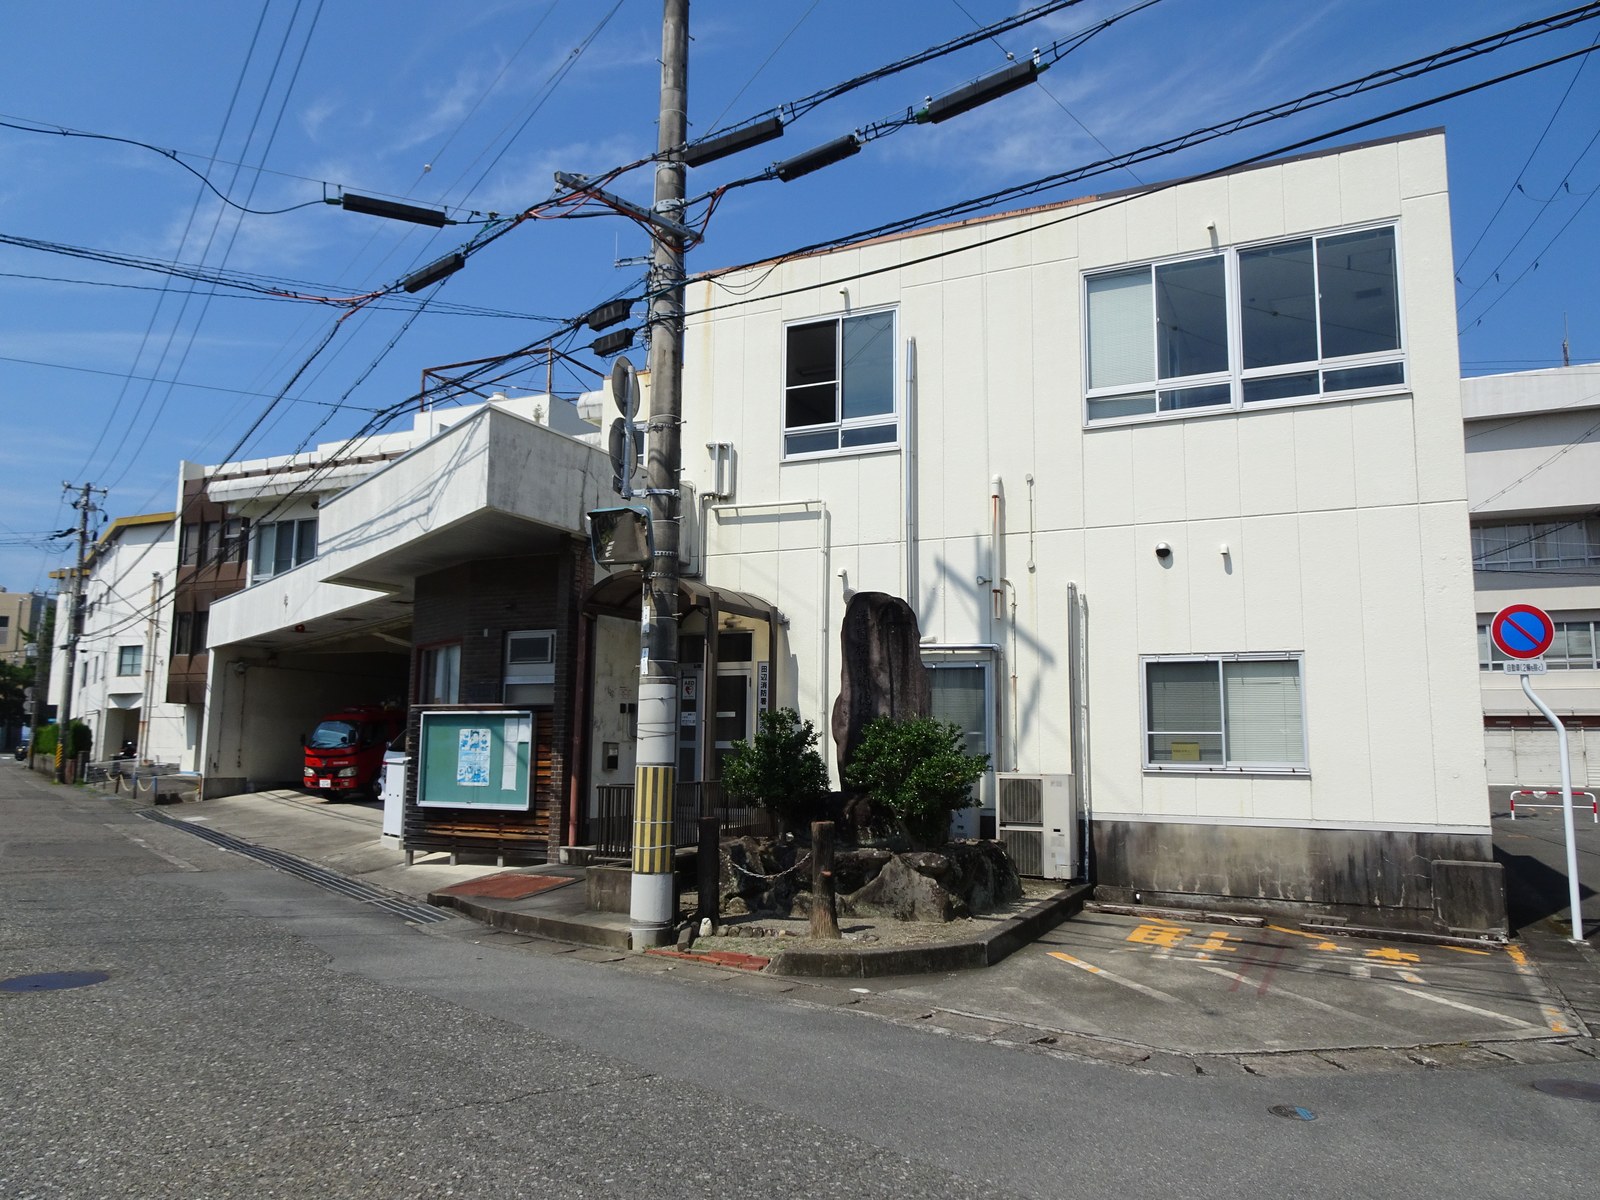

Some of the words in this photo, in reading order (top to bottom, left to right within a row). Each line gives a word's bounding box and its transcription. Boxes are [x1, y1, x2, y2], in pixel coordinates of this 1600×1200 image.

[760, 665, 768, 705] 田辺消防署
